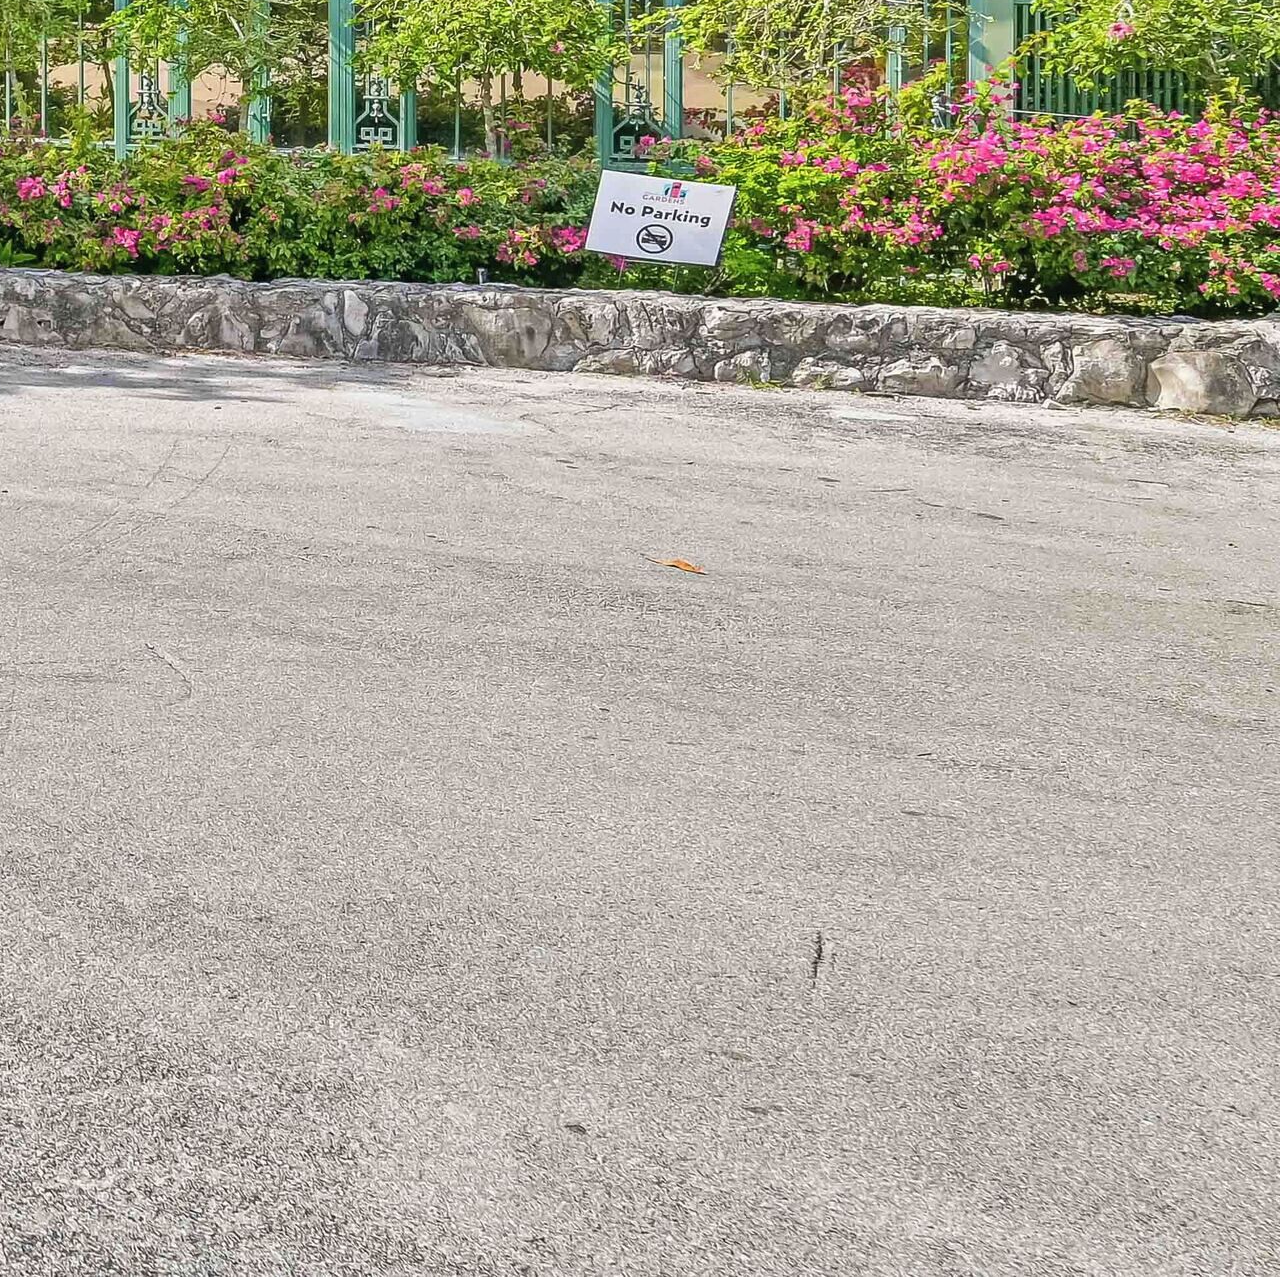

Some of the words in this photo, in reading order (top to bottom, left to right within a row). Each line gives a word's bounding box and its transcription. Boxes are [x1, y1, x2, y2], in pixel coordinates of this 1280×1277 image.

[642, 194, 685, 205] GARDENS
[610, 201, 635, 215] No
[642, 206, 711, 228] Parking
